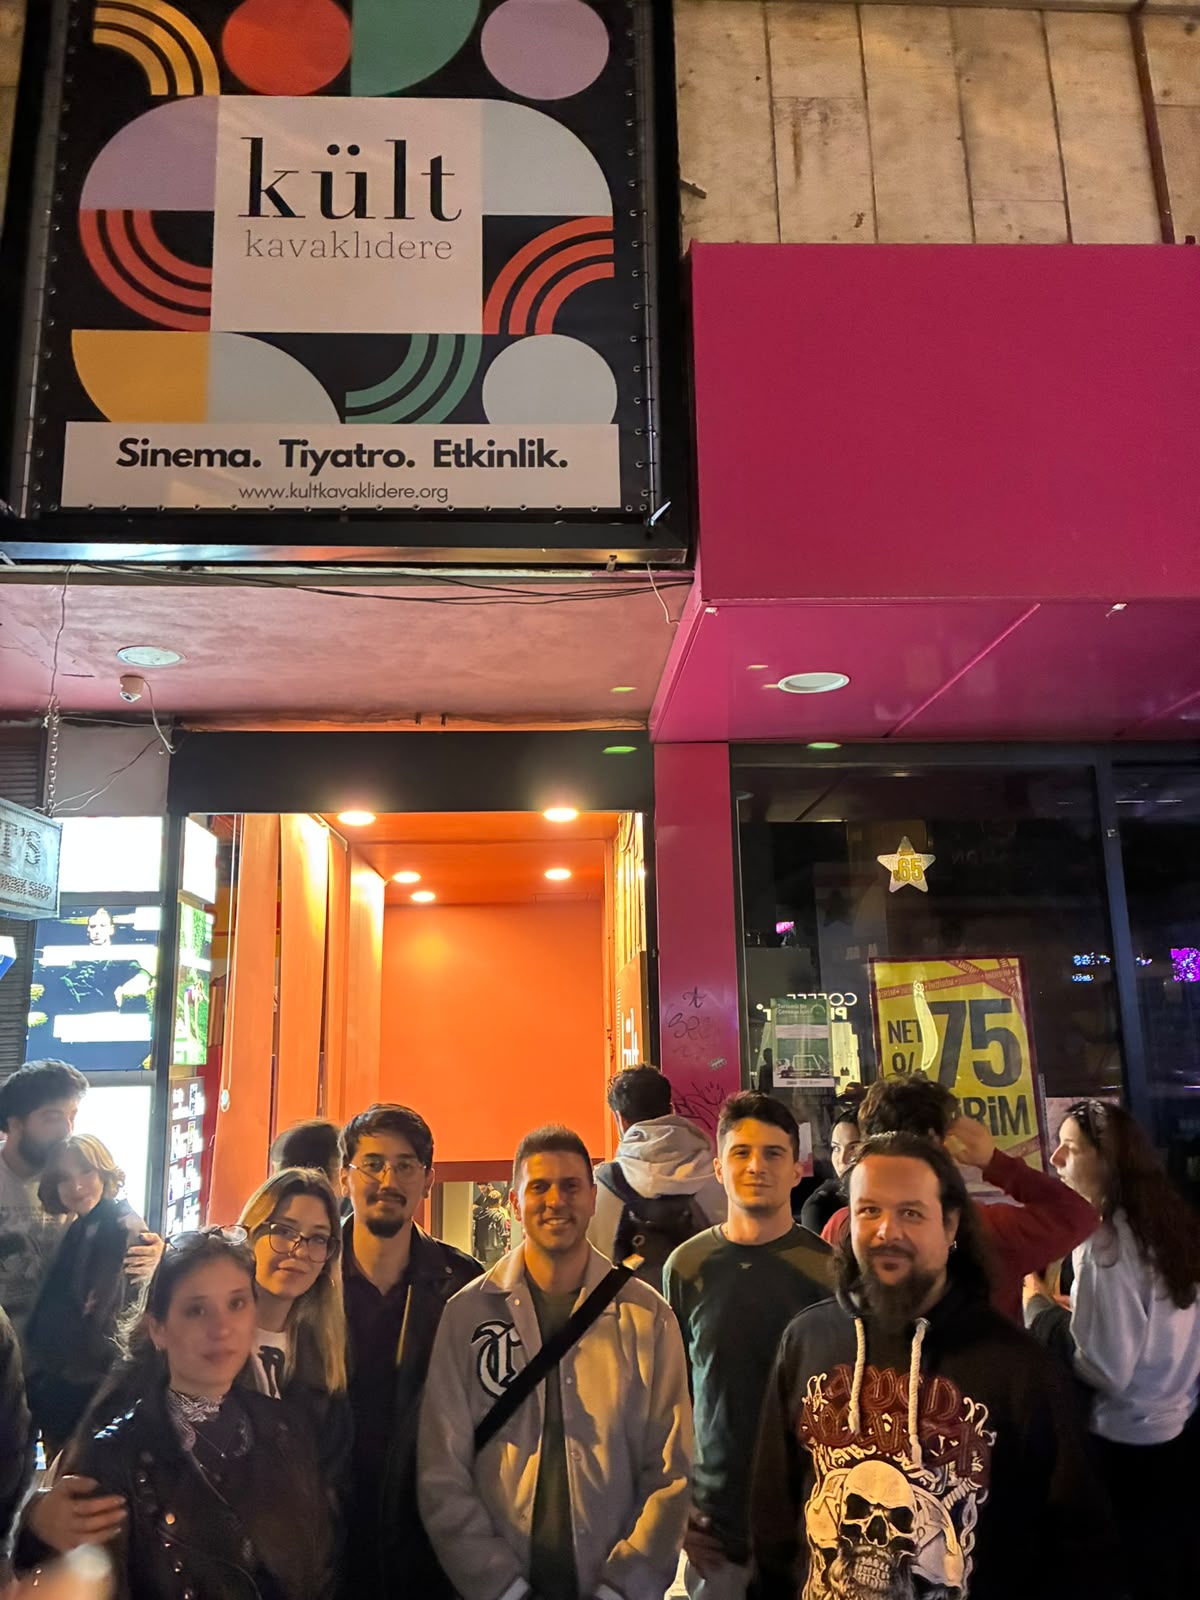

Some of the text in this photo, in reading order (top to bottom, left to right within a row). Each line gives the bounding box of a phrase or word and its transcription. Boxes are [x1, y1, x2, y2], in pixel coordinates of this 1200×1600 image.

[237, 136, 463, 222] kült
[244, 230, 453, 261] kavaklıdere
[115, 438, 569, 477] Sinema. Tiyatro. Etkinlik.
[238, 482, 449, 502] www.kultkavaklidere.org
[887, 1019, 923, 1044] NET
[926, 998, 1023, 1088] 75
